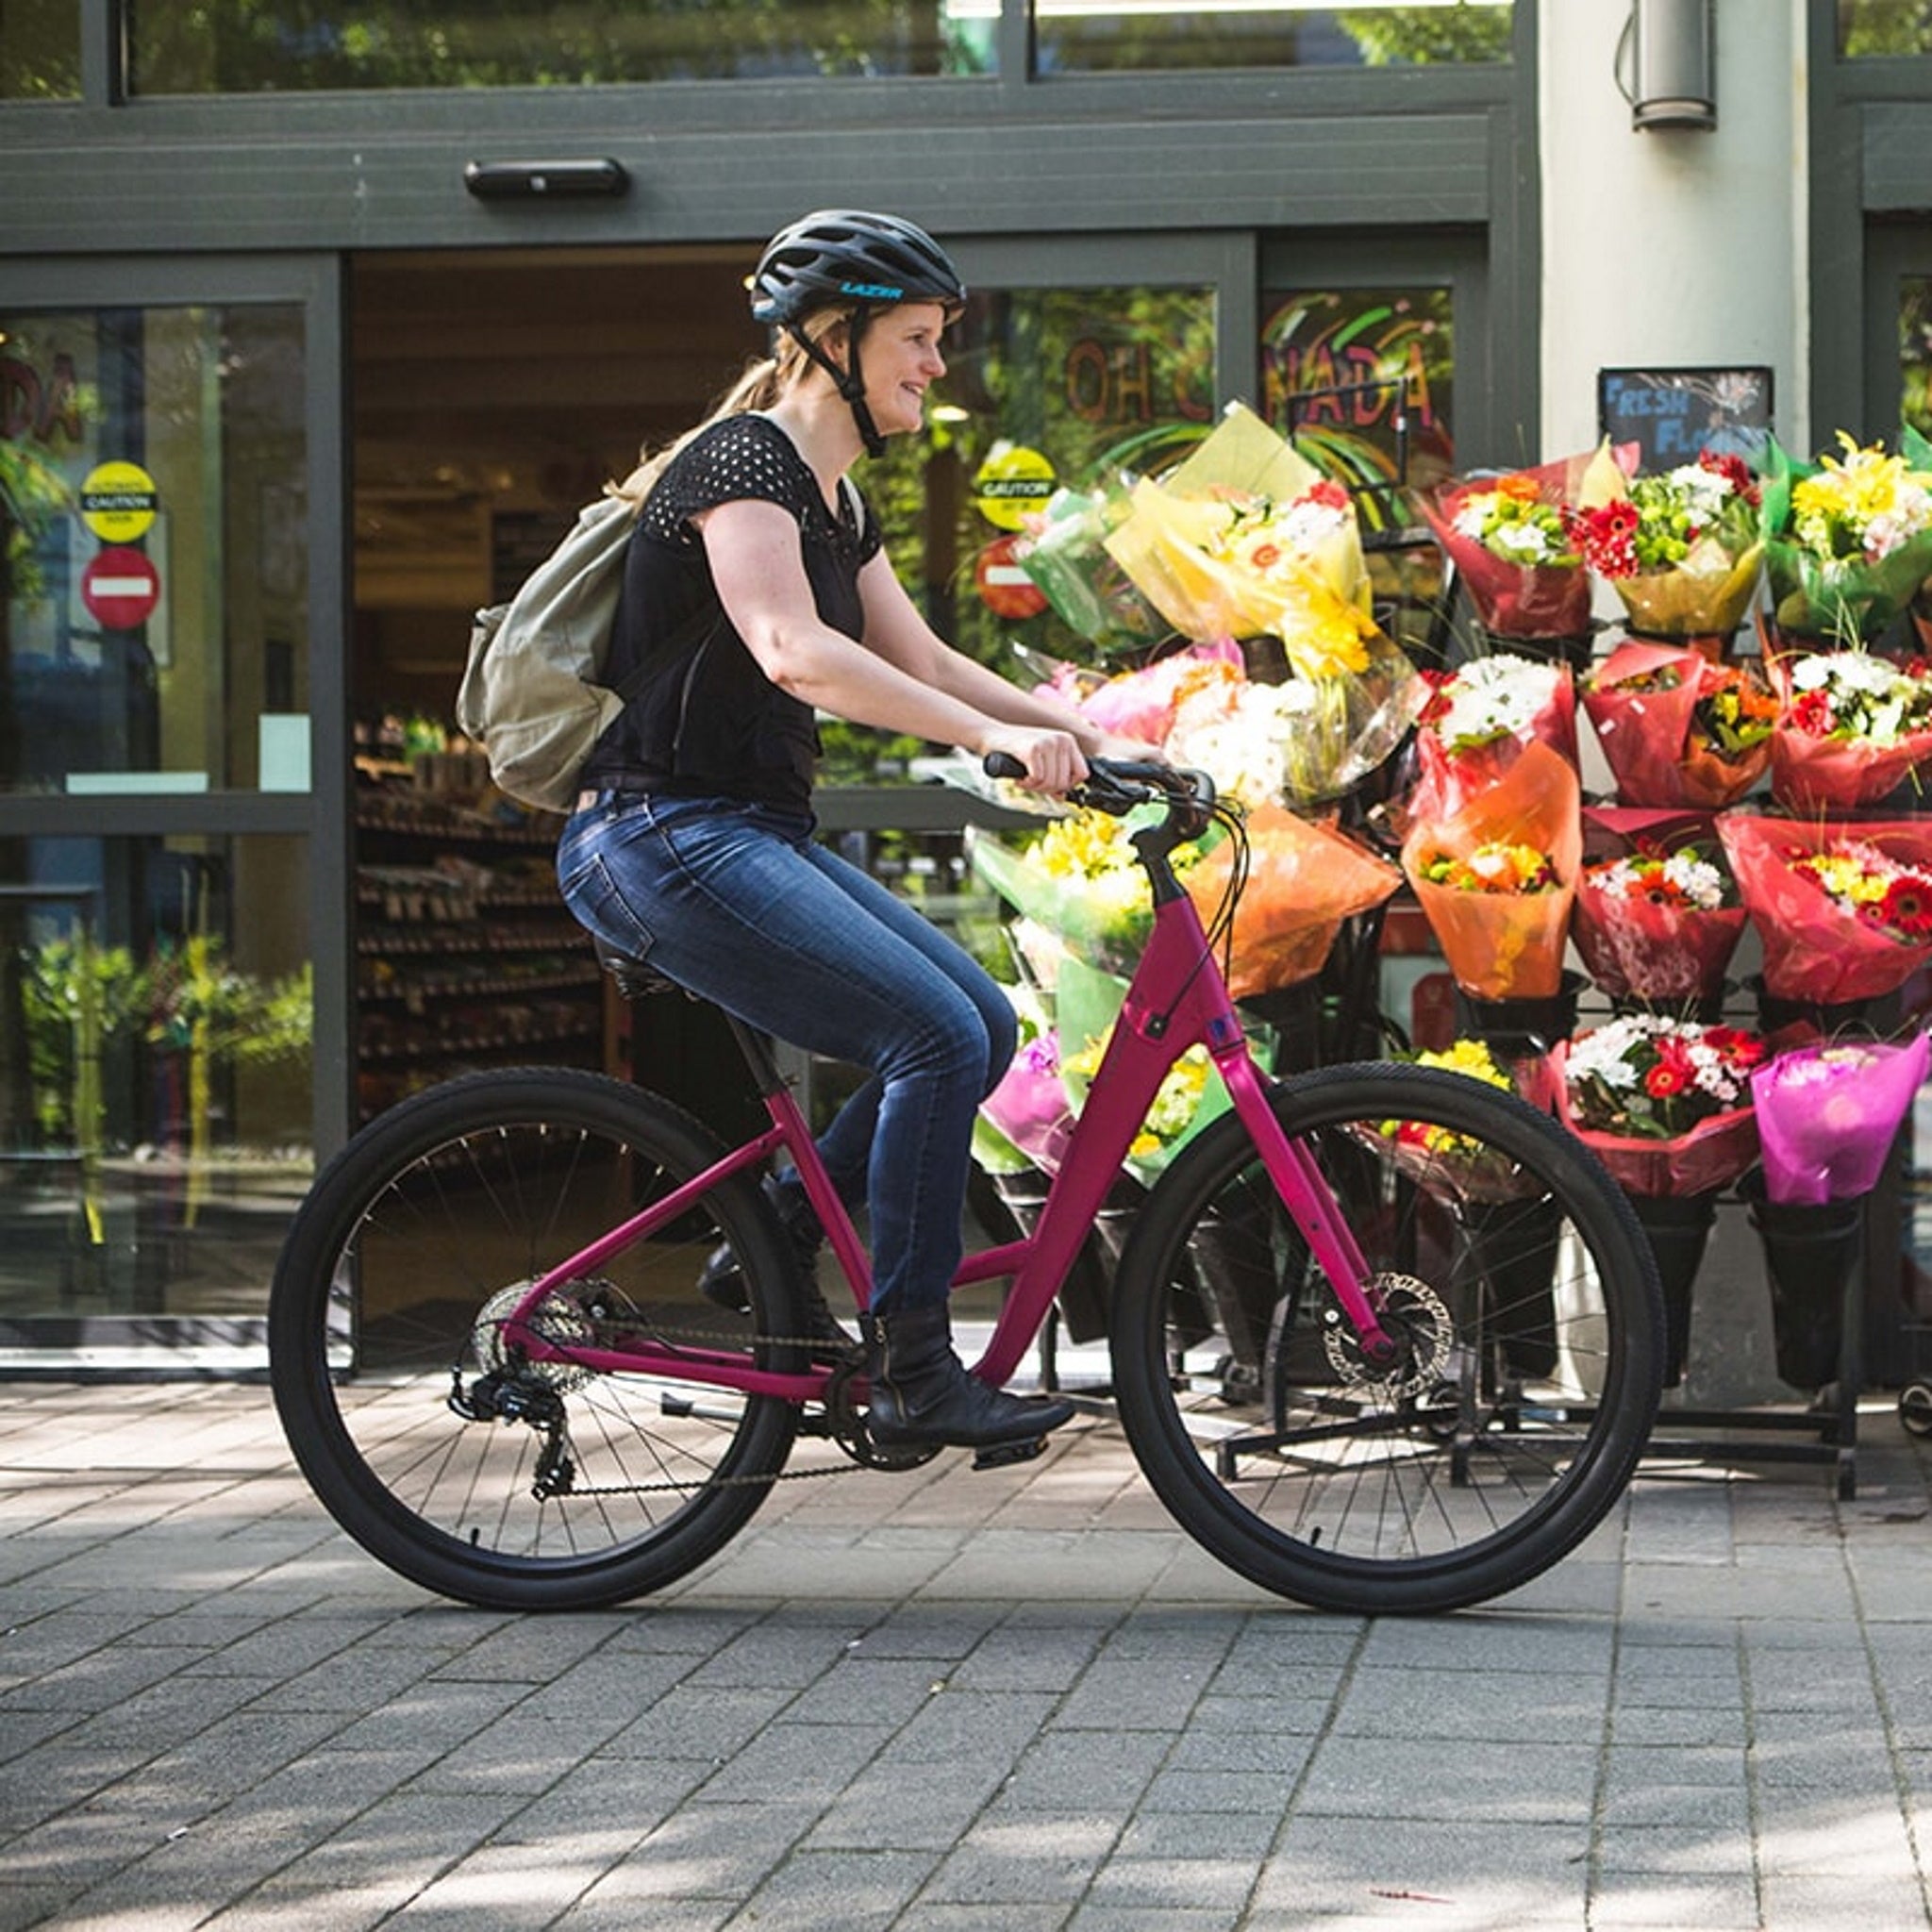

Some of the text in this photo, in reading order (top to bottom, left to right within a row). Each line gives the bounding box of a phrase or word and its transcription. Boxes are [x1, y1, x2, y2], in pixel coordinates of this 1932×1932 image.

[840, 280, 906, 300] LAZER
[1067, 339, 1433, 428] OH CNADA
[1606, 377, 1689, 416] FRESH
[982, 482, 1051, 496] CAUTION
[87, 495, 151, 509] CAUTION
